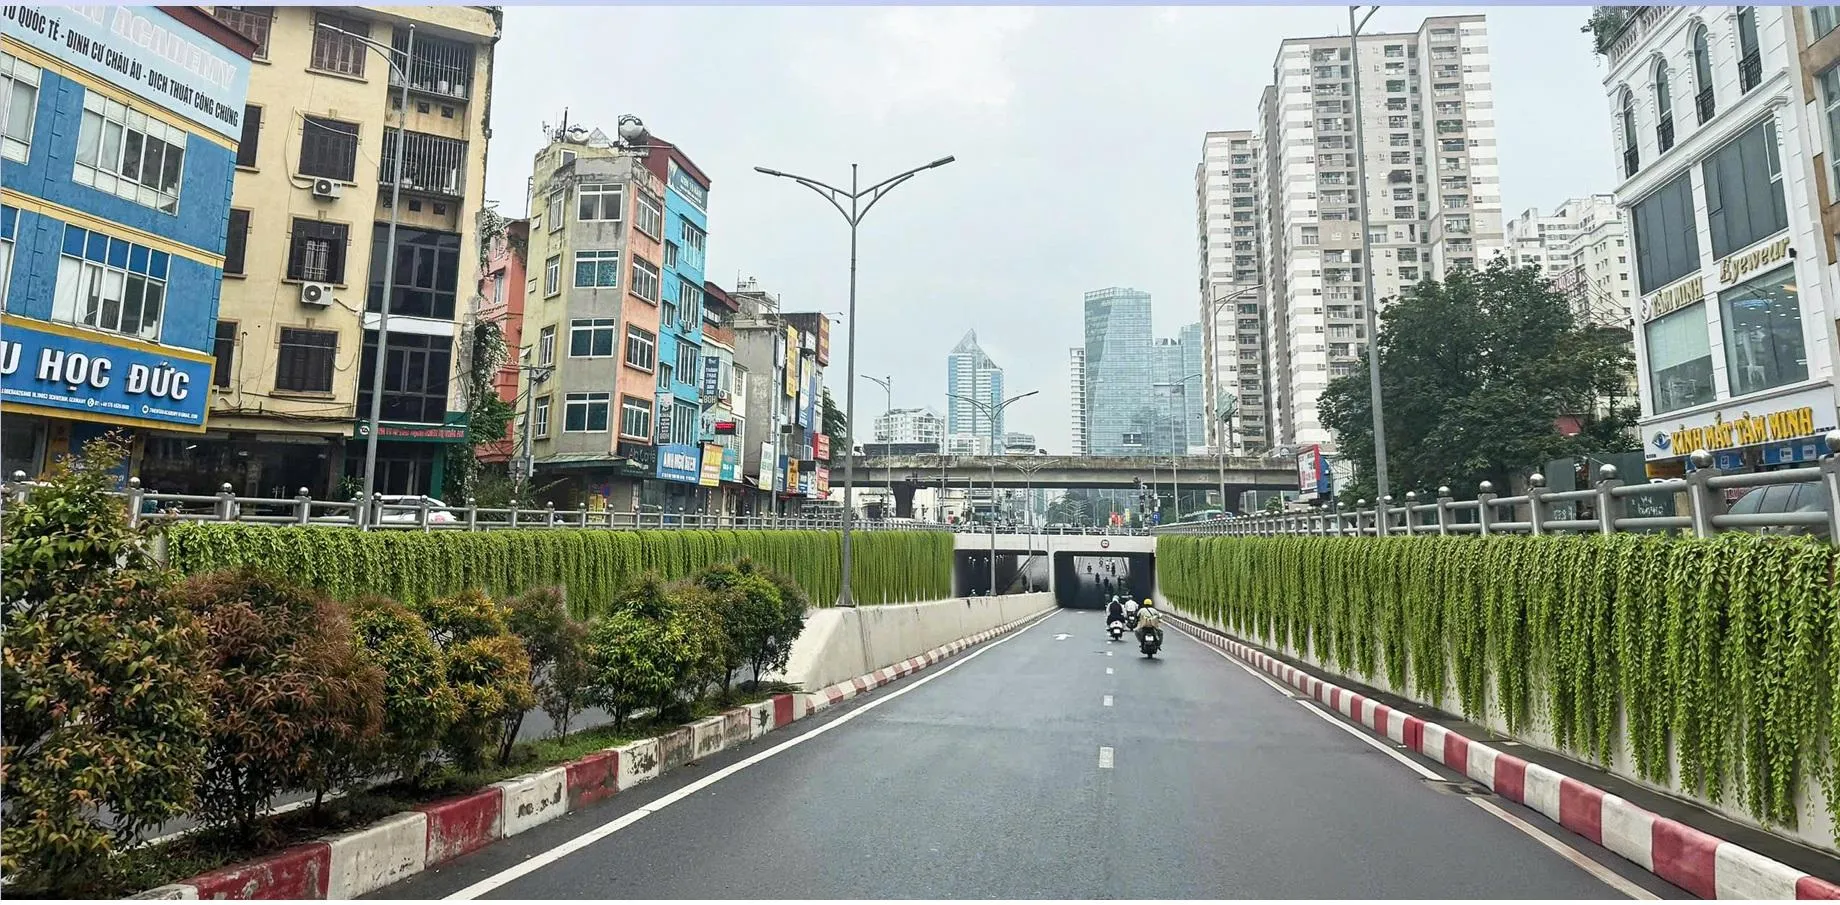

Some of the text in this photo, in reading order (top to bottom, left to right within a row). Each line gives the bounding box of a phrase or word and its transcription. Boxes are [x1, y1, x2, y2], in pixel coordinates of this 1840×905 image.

[18, 6, 46, 34] QUỐC
[48, 17, 61, 41] TẾ
[90, 41, 106, 62] CƯ
[105, 48, 129, 74] CHÂU
[169, 79, 193, 106] THUẬT
[194, 91, 214, 115] CÔNG
[214, 102, 239, 127] CHỨNG
[1719, 237, 1790, 284] Eyewear
[1674, 276, 1704, 308] MINH
[37, 348, 112, 390] HỌC
[127, 361, 190, 400] ĐỨC
[1672, 424, 1703, 455] KÍNH
[1704, 411, 1734, 450] MẮT
[1768, 407, 1814, 440] MINH
